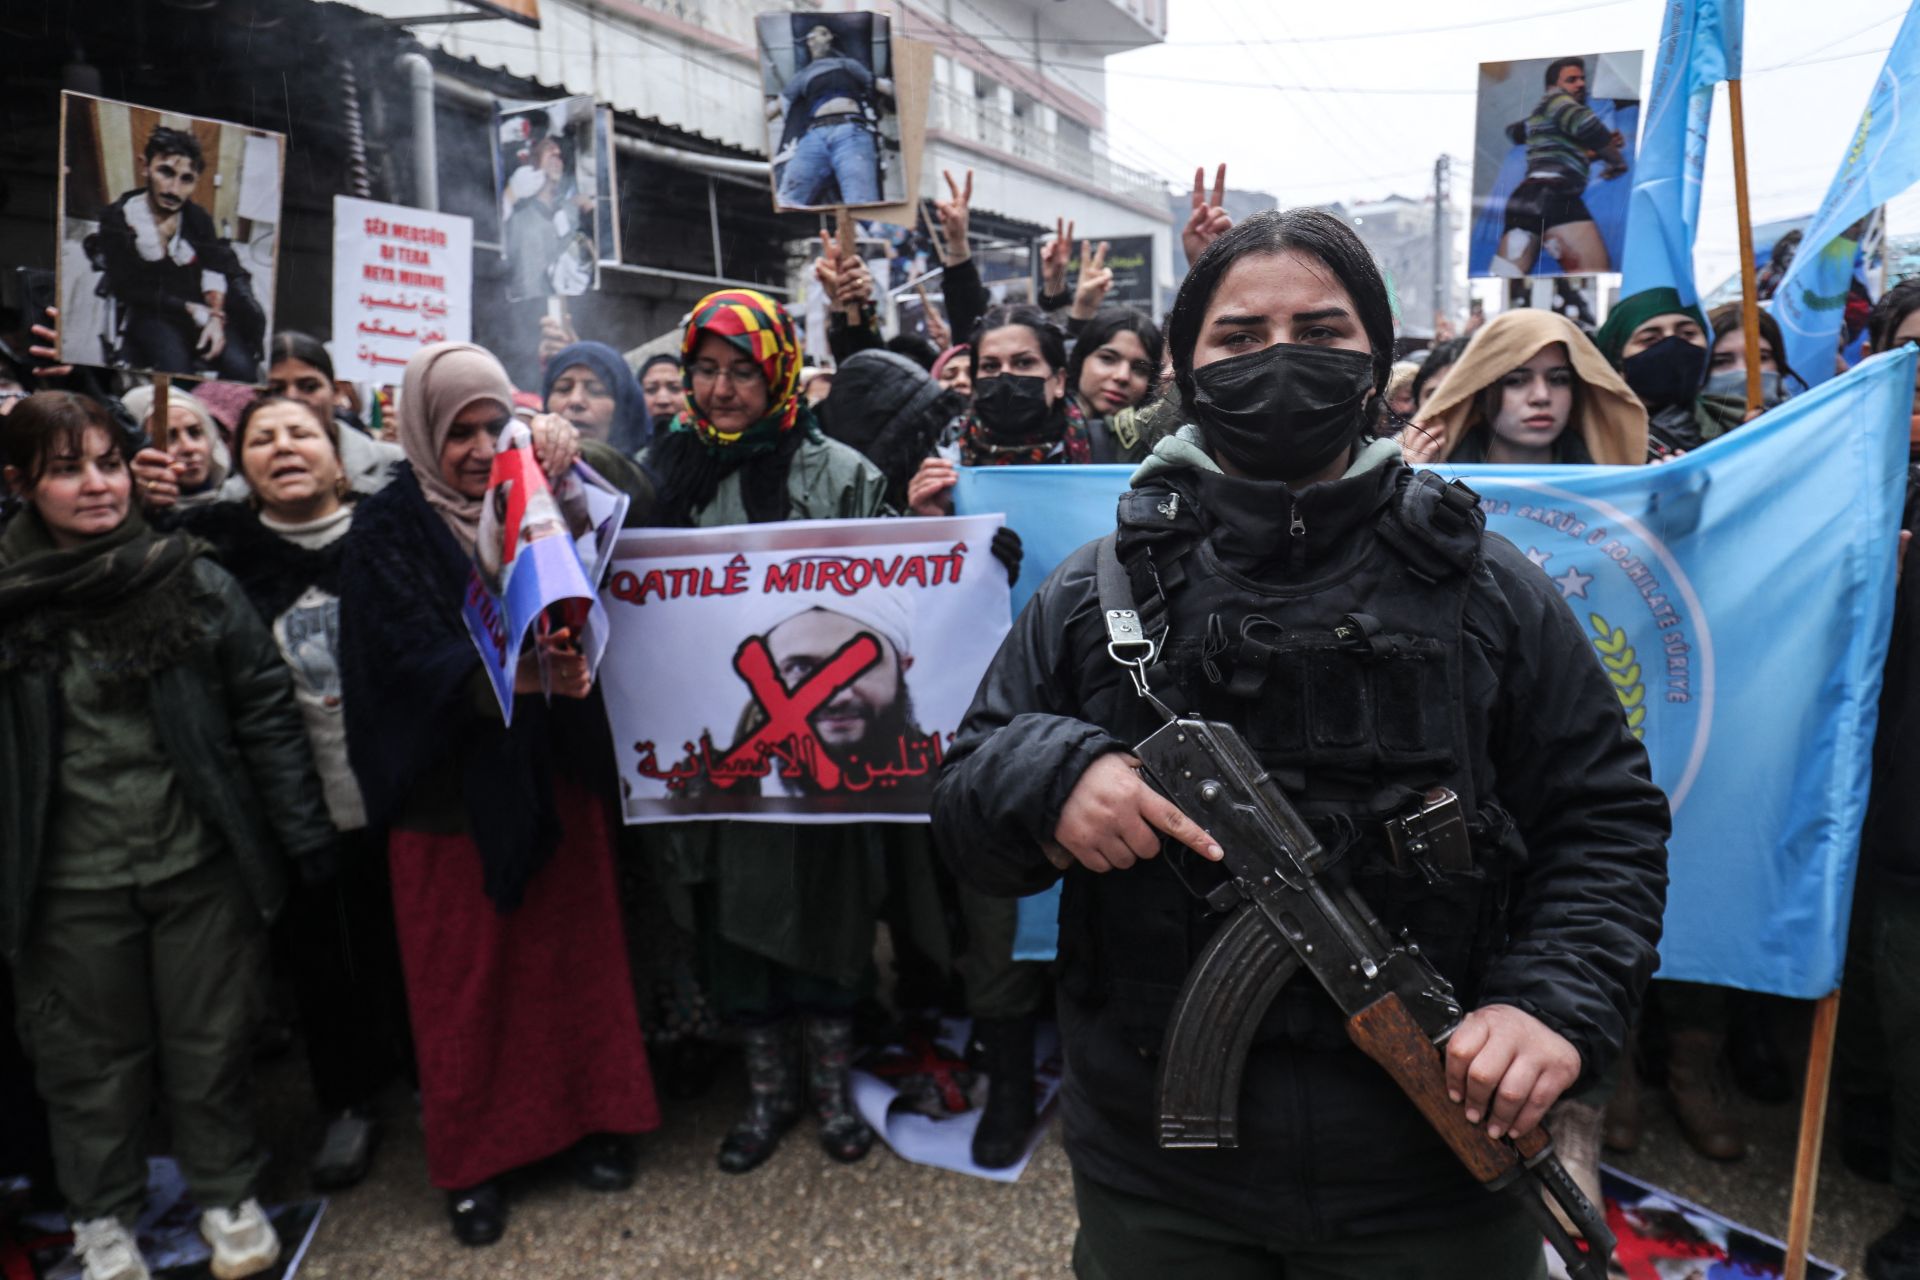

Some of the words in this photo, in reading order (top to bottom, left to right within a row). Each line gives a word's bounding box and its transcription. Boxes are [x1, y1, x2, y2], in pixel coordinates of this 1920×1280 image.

[610, 554, 750, 606] QATILÊ
[764, 541, 969, 596] MIROVATÎ
[843, 731, 956, 791] اتلين
